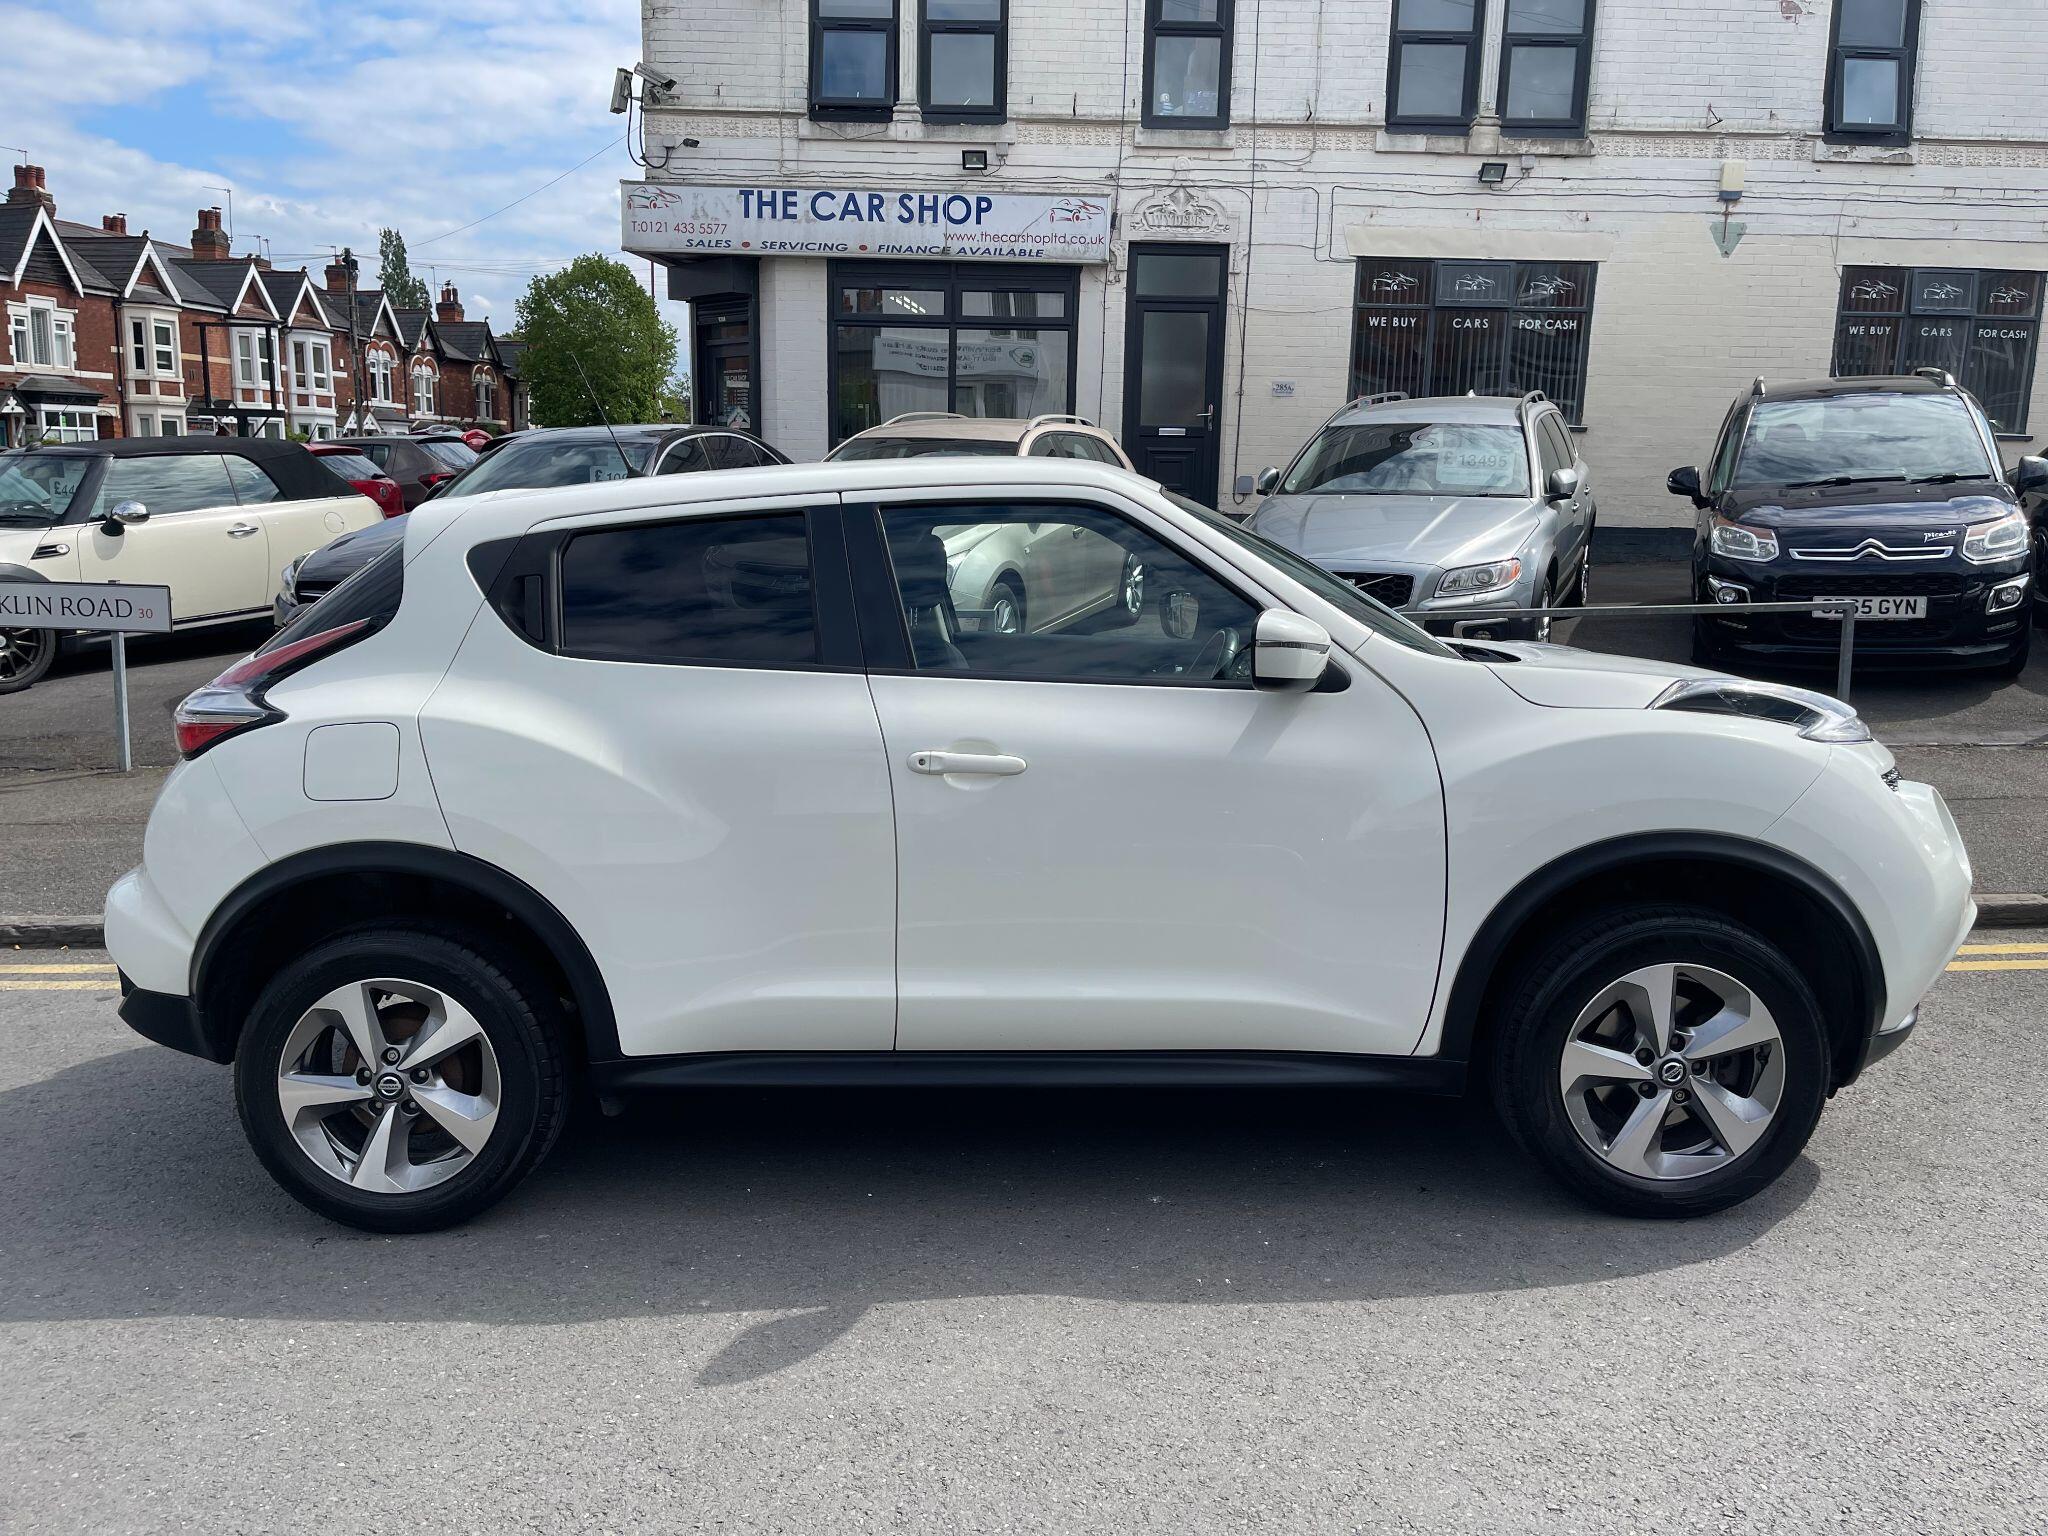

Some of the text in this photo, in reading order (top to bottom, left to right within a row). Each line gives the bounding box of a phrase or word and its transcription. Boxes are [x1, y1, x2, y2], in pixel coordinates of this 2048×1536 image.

[738, 189, 798, 220] THE
[810, 190, 886, 222] CAR
[897, 193, 993, 226] SHOP
[631, 221, 728, 235] T:0121 433 5577
[943, 231, 1105, 246] www.thecarshopltd.co.uk
[685, 238, 1045, 258] SALES SERVICING FINANCE AVAILABLE
[1368, 316, 1578, 331] WE BUY CARS FOR CASH
[1848, 325, 2027, 339] WE BUY CARS FOR CASH
[61, 597, 133, 618] ROAD
[138, 608, 153, 619] 30
[1878, 598, 1918, 615] GYN
